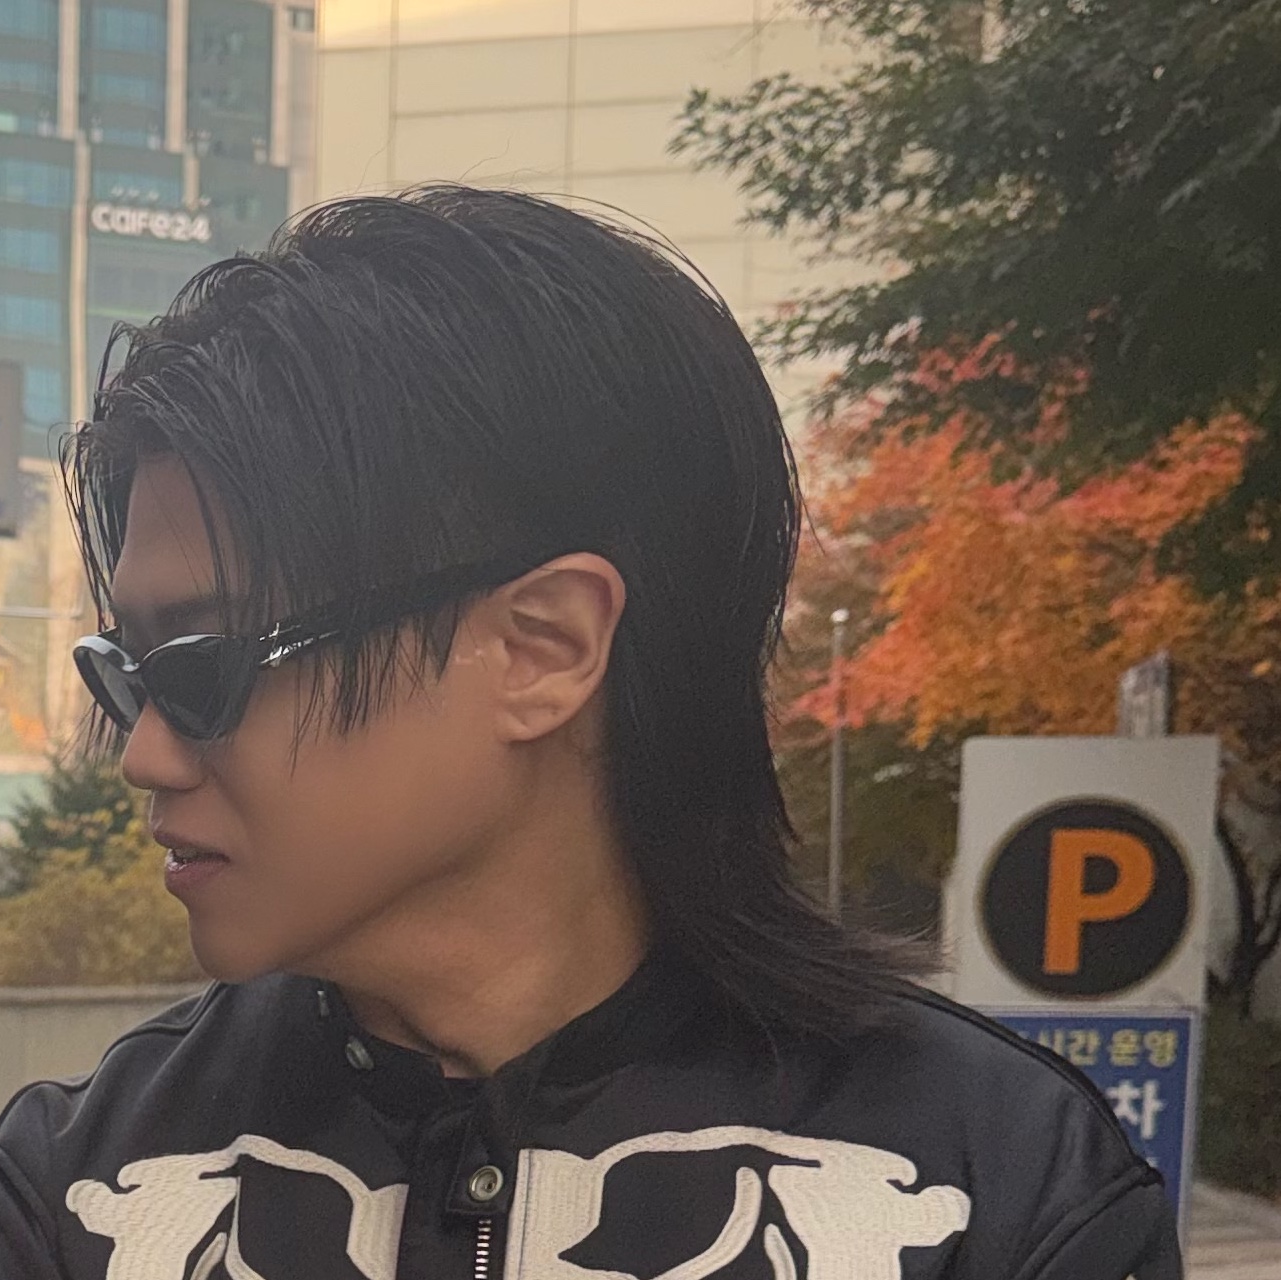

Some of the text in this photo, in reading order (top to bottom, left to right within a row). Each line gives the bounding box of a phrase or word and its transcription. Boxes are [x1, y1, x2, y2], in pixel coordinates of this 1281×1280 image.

[1043, 828, 1155, 976] P
[1021, 1028, 1178, 1068] 시간 운영
